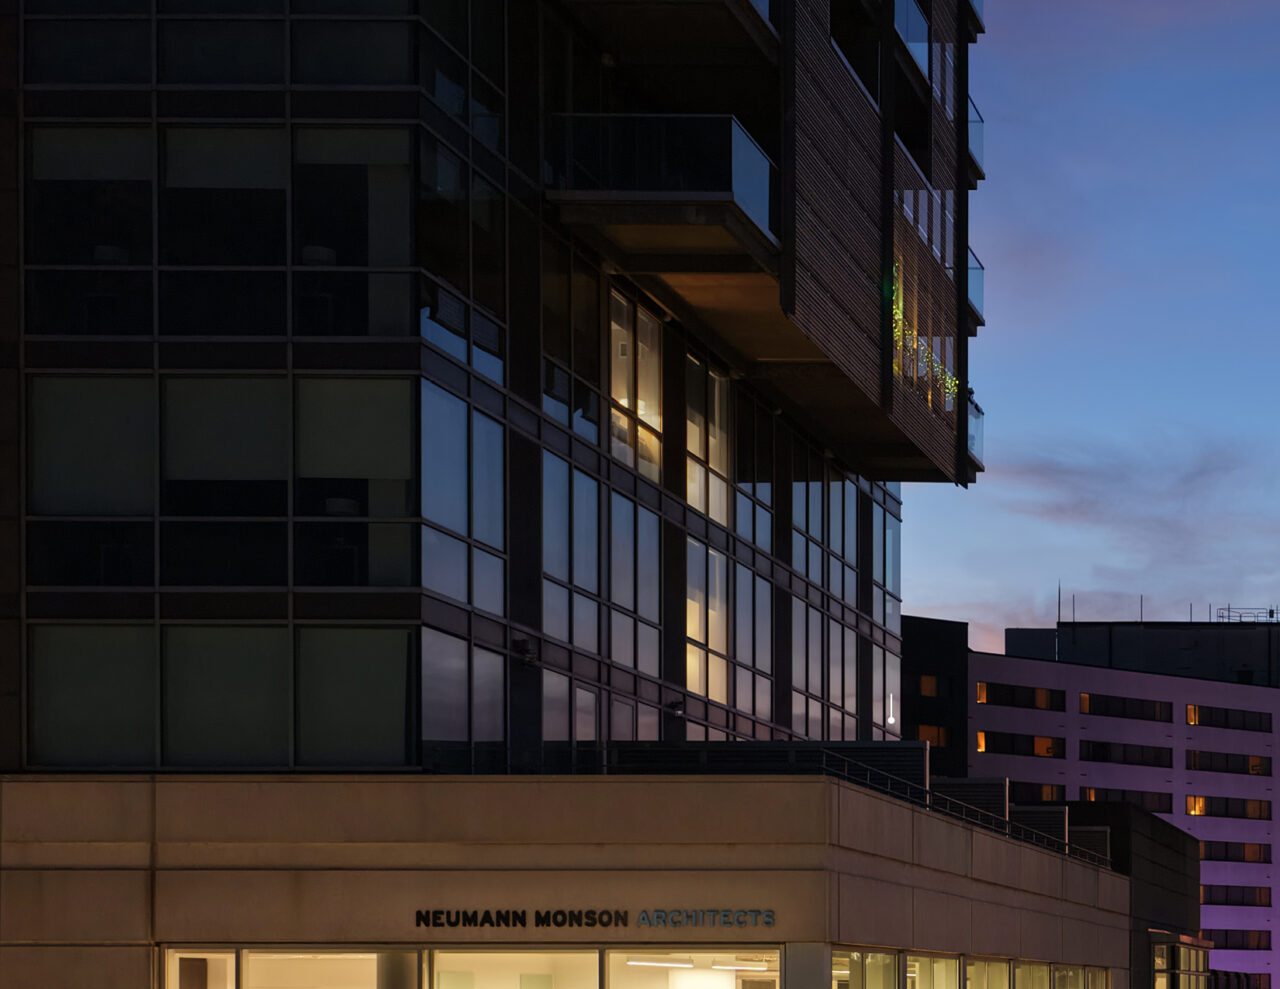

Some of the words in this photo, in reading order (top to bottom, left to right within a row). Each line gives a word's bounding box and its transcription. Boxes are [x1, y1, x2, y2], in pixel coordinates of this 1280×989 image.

[415, 910, 527, 928] NEUMANN
[534, 910, 629, 928] MONSON
[636, 909, 776, 928] ARCHITECTS
